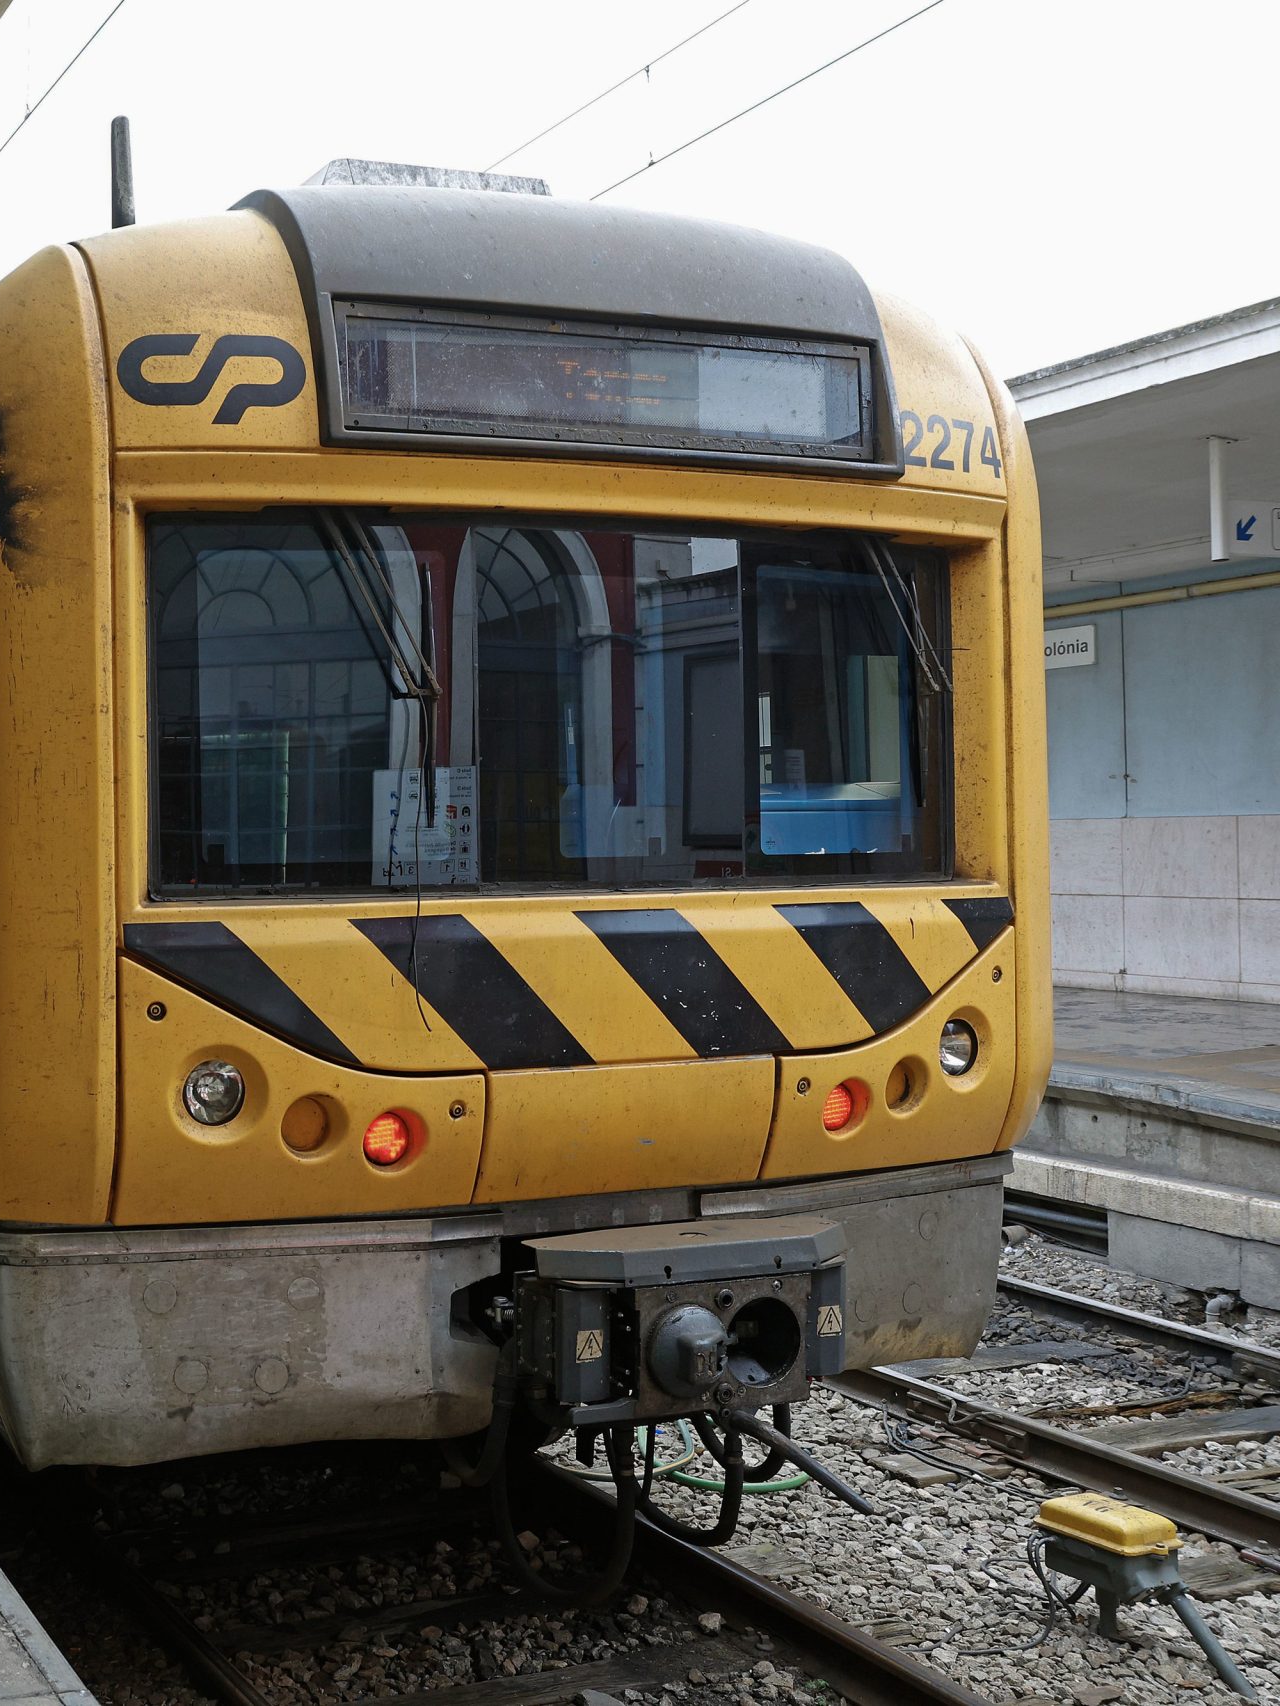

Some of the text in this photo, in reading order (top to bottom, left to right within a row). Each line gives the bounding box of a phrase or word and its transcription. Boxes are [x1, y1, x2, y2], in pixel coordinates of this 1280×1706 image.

[116, 333, 307, 424] CP
[900, 410, 1002, 479] 2274
[1044, 639, 1088, 657] olónia
